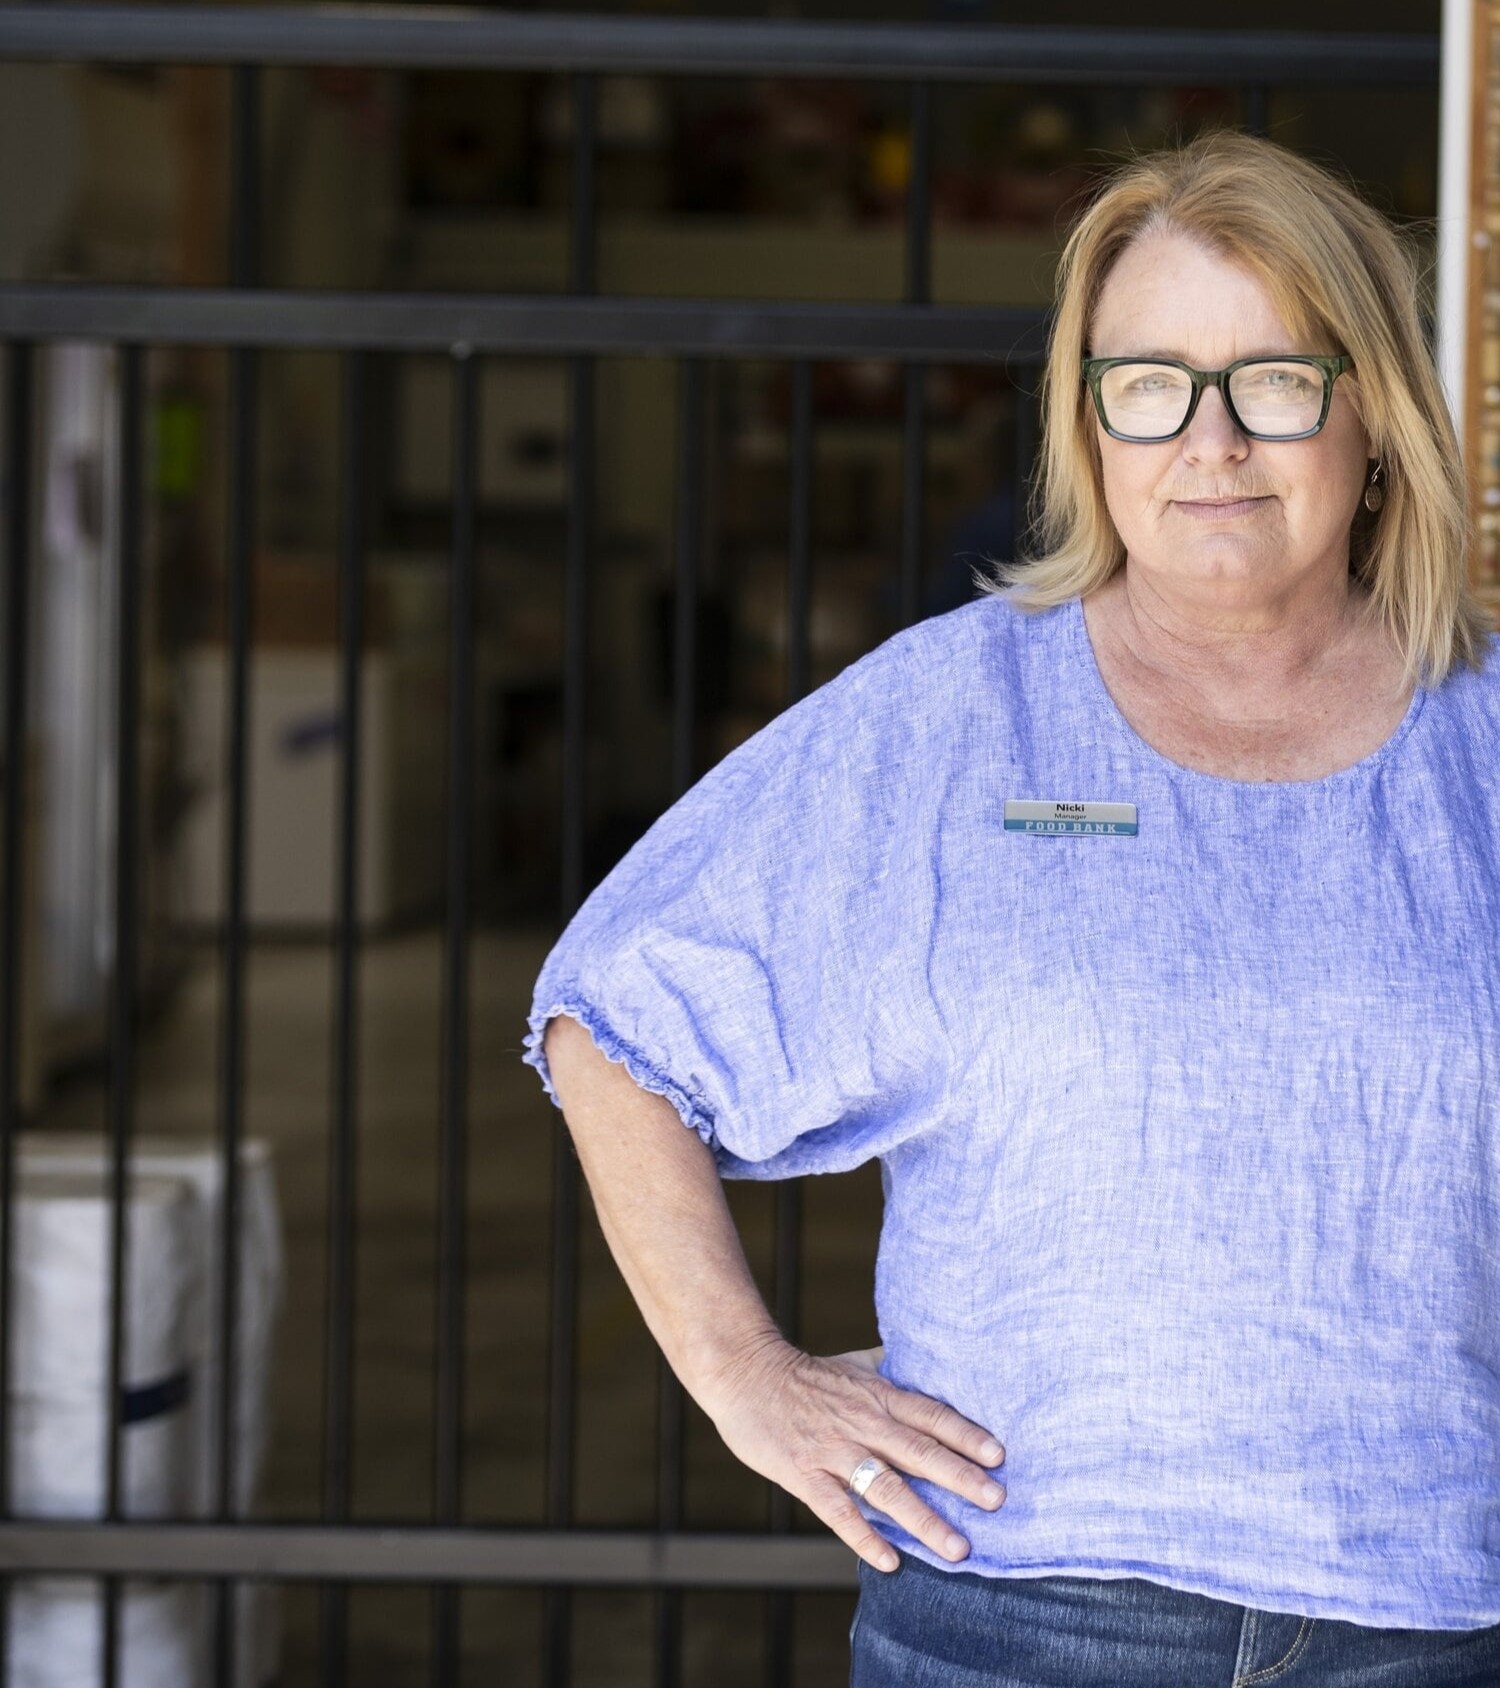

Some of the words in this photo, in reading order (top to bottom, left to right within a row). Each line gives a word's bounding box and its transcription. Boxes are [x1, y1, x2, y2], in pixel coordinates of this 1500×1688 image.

[1056, 803, 1085, 812] Nicki
[1025, 821, 1067, 832] FOOD
[1073, 822, 1117, 833] BANK
